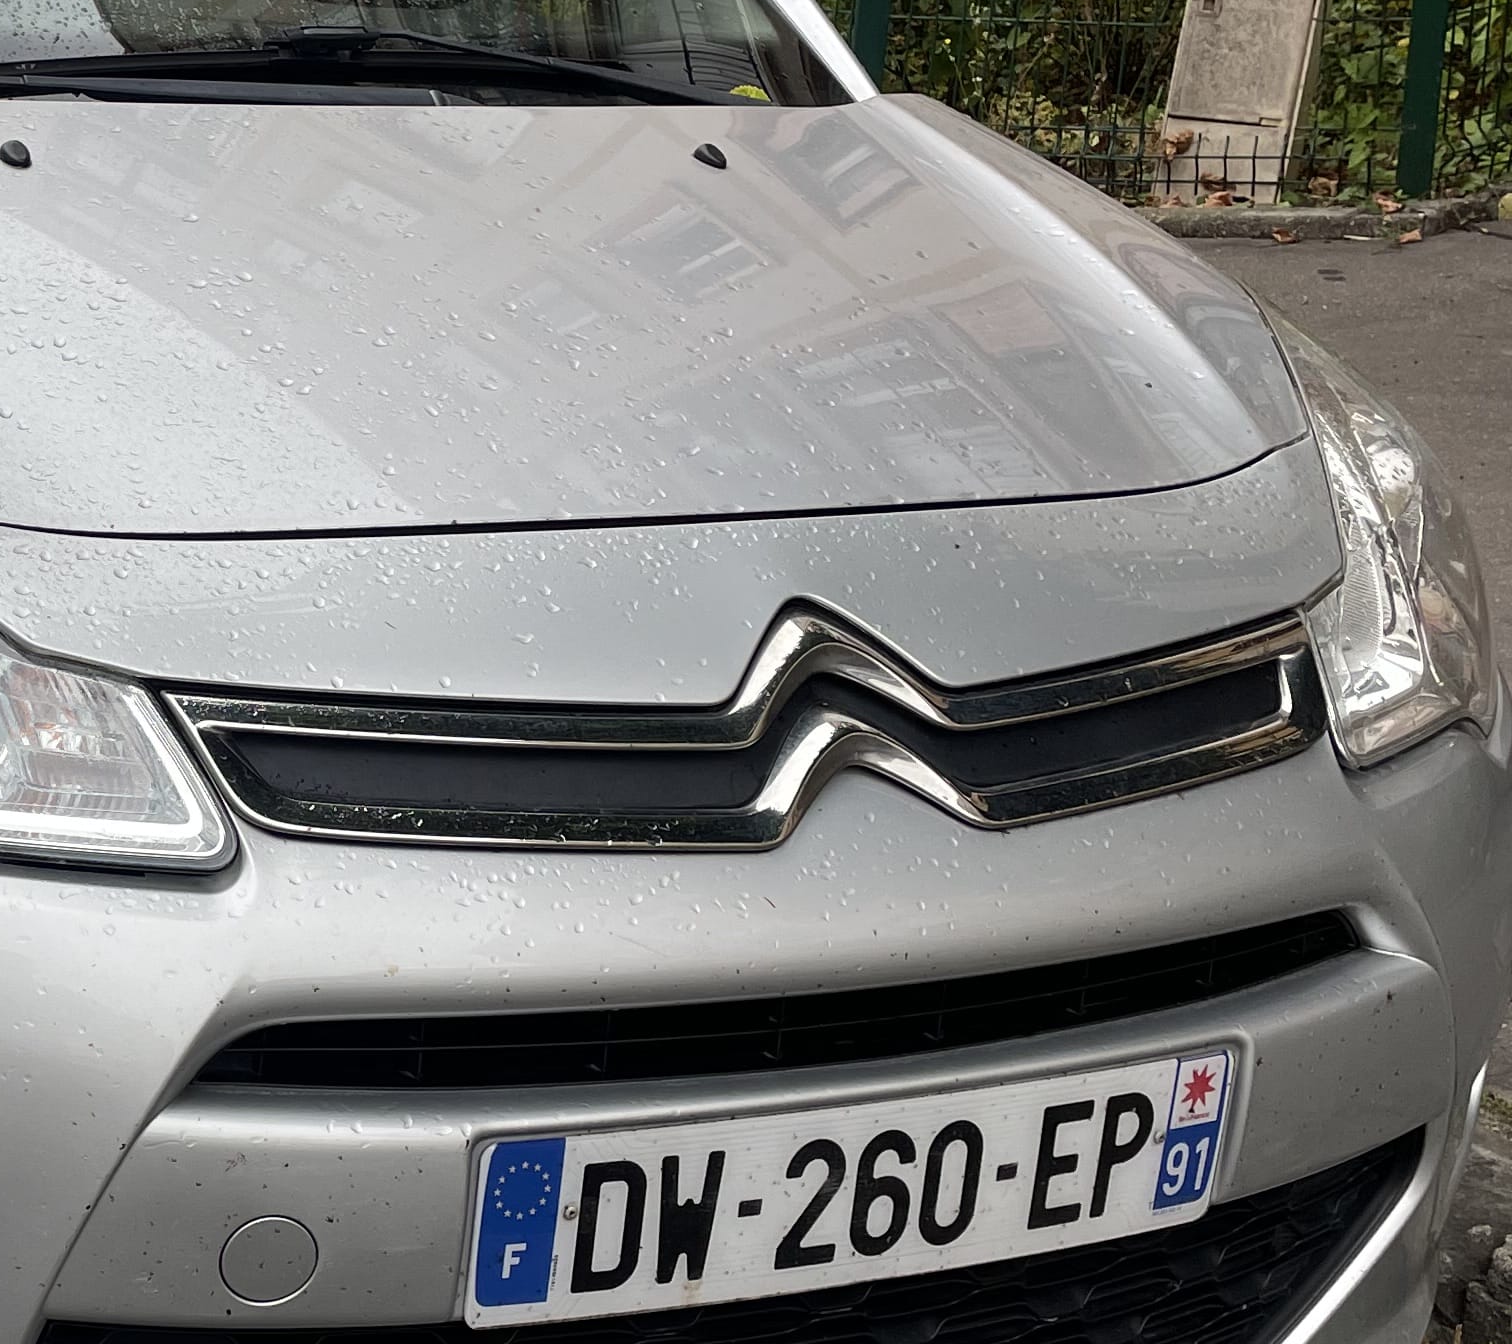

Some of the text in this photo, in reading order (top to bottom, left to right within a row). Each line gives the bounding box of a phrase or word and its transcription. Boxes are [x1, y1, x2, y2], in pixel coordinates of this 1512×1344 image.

[570, 1091, 1155, 1294] DW-260-EP
[1161, 1136, 1211, 1196] 91
[501, 1242, 528, 1280] F
